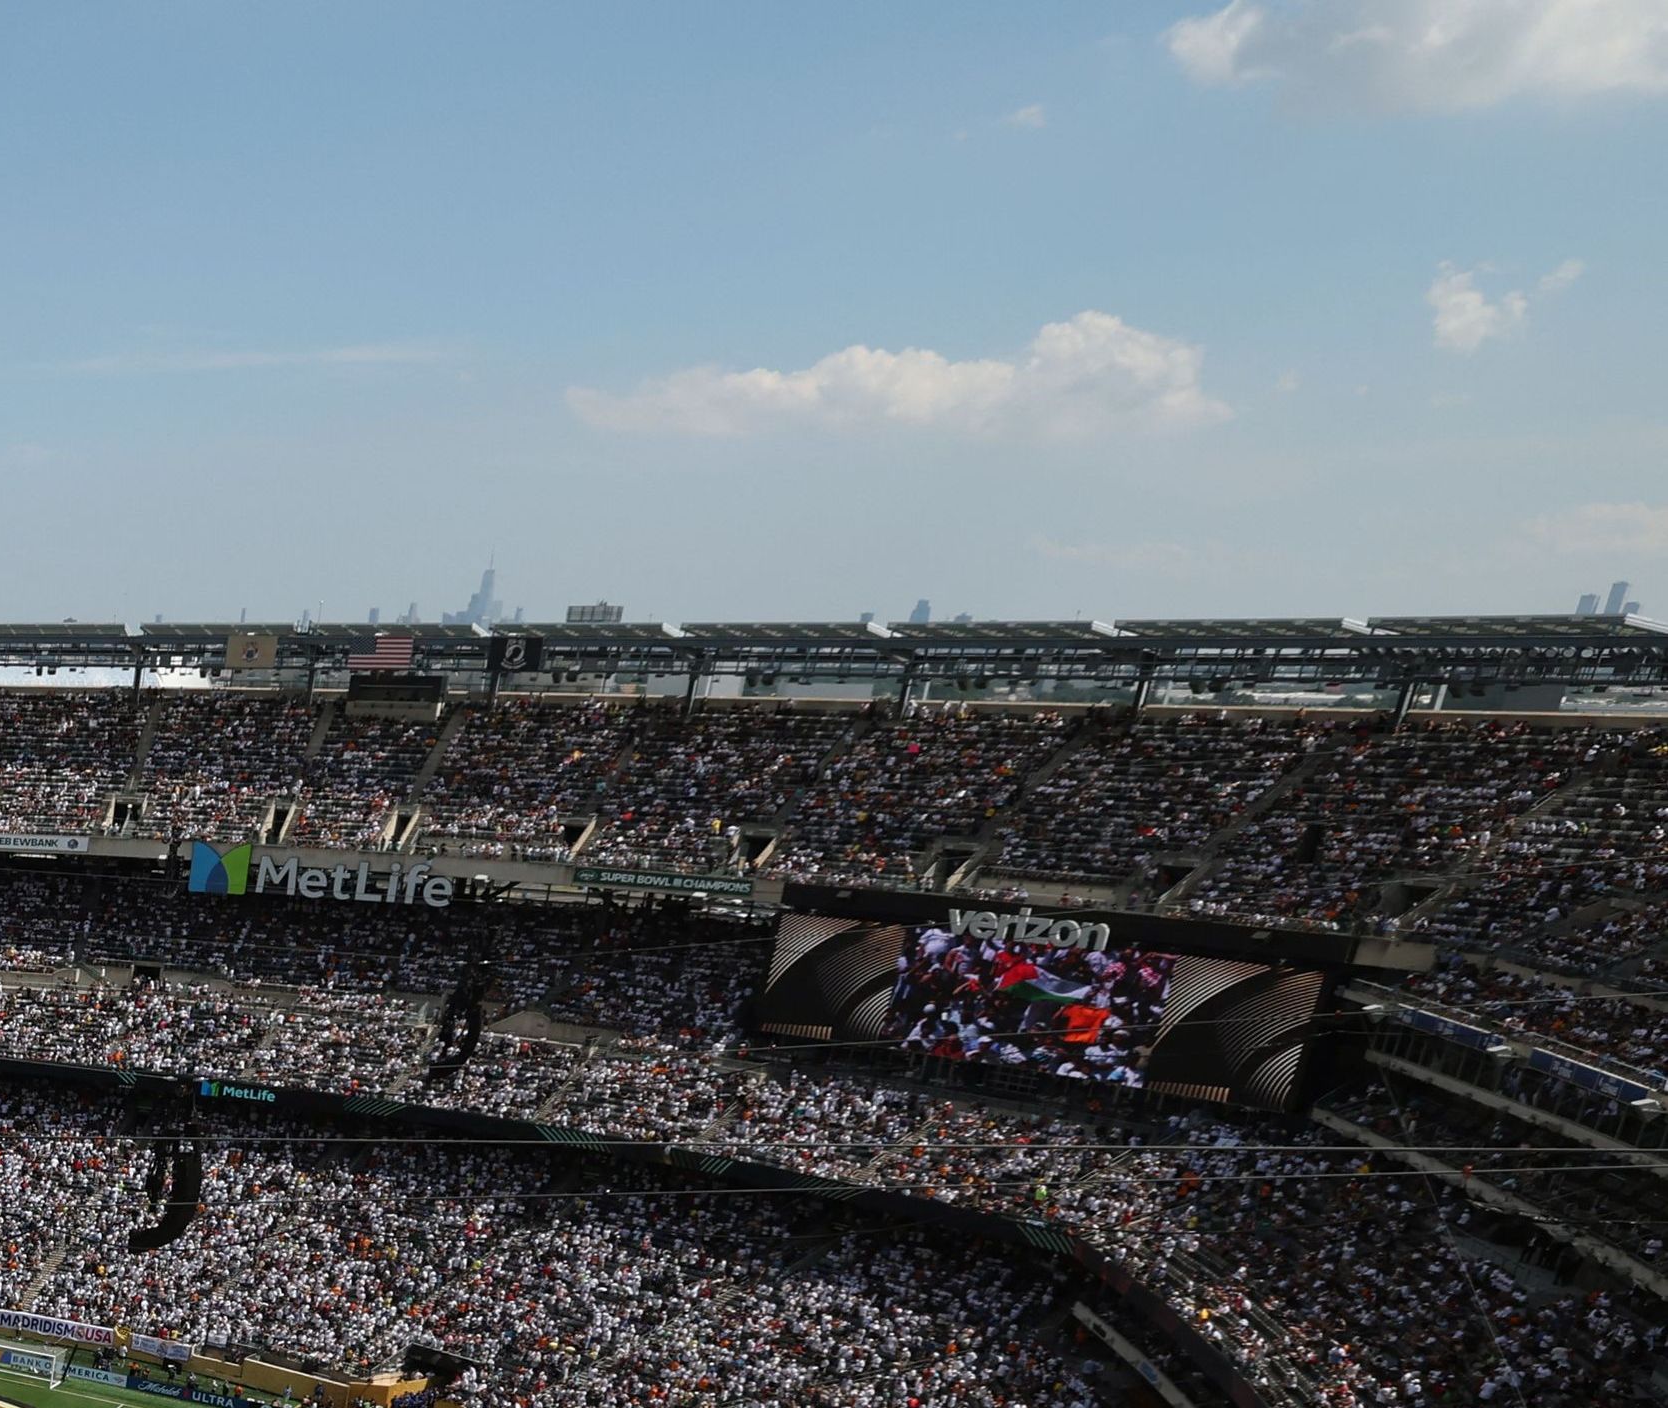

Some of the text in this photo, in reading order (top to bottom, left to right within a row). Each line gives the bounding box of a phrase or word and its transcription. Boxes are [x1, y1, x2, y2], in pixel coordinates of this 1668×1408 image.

[13, 838, 59, 848] EWBANK
[255, 855, 453, 908] MetLife
[600, 871, 636, 884] SUPER
[637, 875, 671, 888] BOWL
[683, 878, 752, 893] CHAMPIONS
[948, 907, 1110, 951] verizon
[223, 1086, 276, 1102] MetLife
[13, 1355, 43, 1369] BANK
[137, 1381, 235, 1408] Michelob ULTRA
